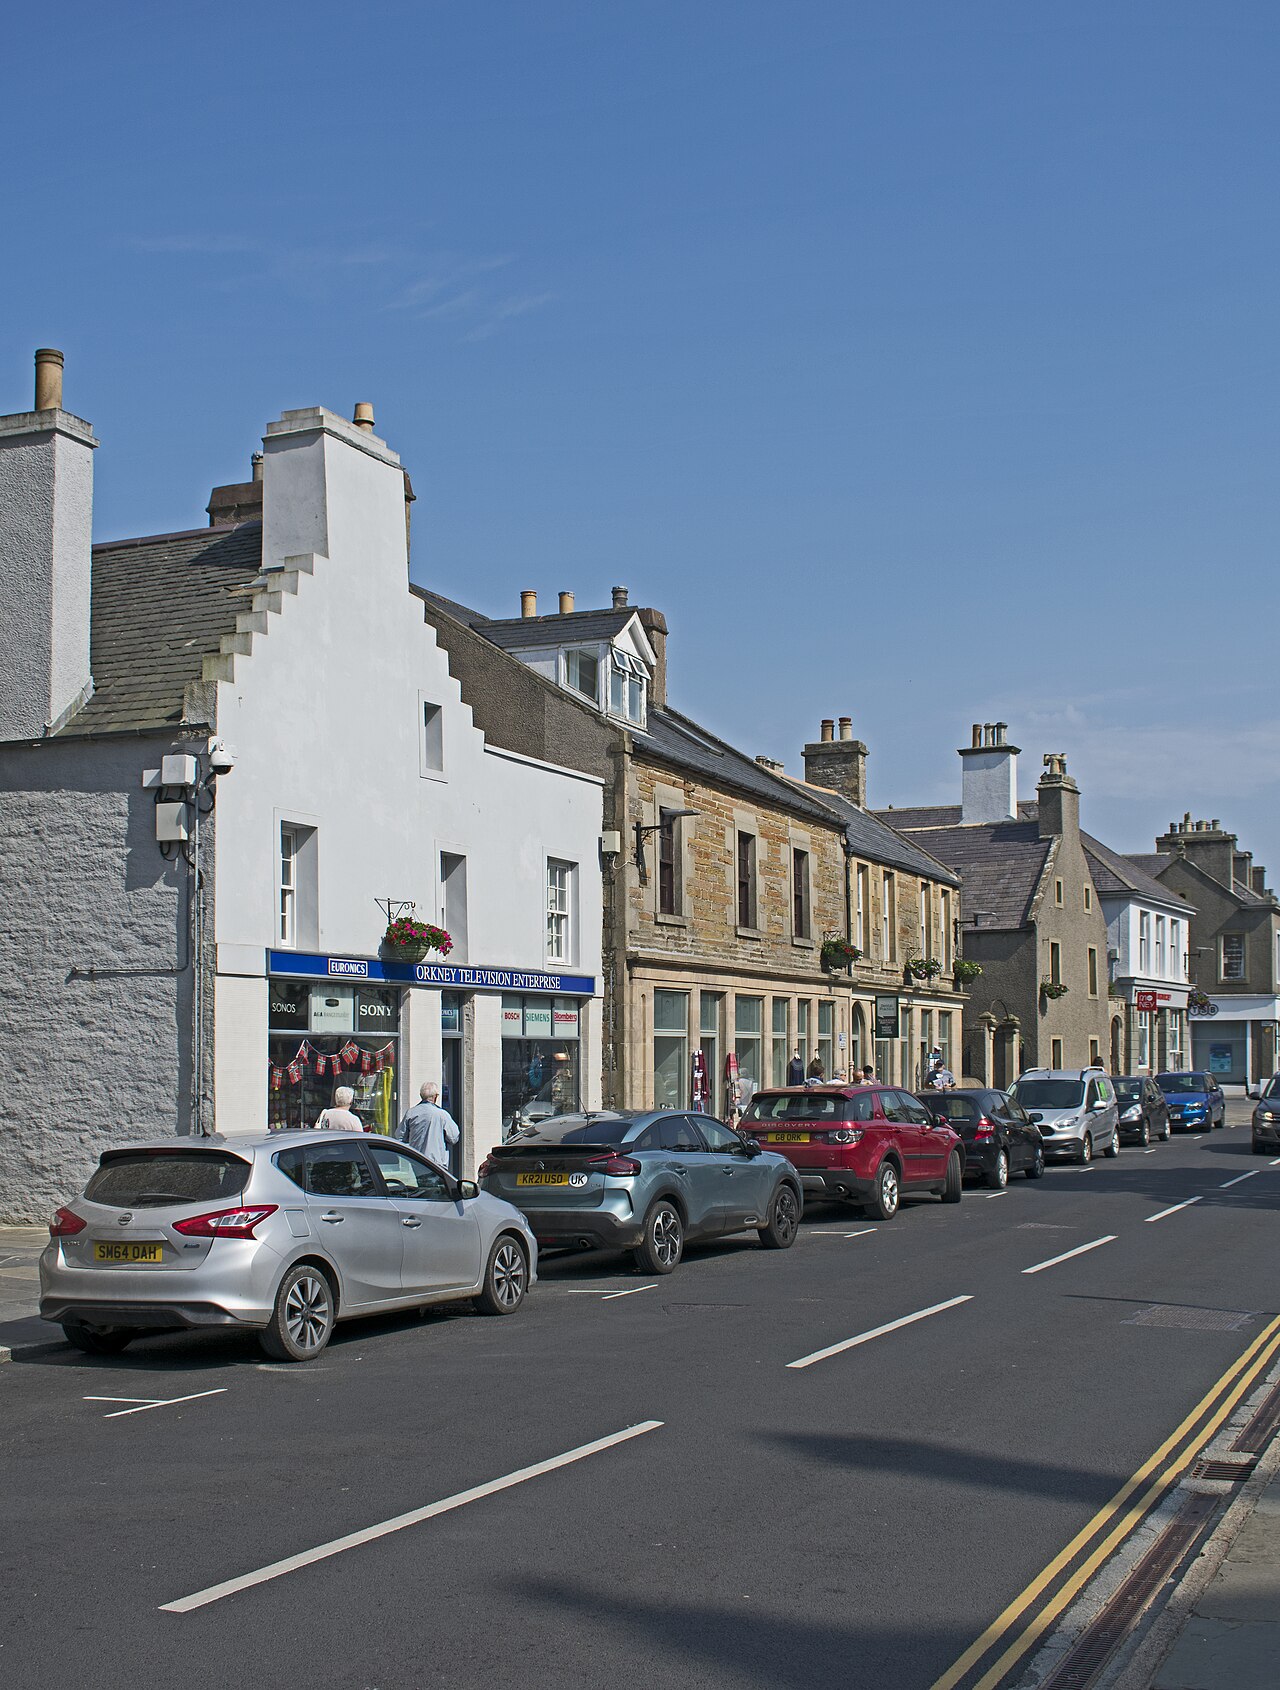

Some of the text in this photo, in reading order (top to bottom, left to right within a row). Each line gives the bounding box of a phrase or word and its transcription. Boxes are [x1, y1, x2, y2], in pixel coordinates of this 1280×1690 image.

[331, 961, 366, 974] EURONICS
[416, 965, 561, 990] ORKNEY TELEVISION ENTERPRISE
[271, 1002, 296, 1013] SONOS
[360, 1004, 393, 1017] SONY
[504, 1012, 520, 1020] BOSCH
[526, 1012, 550, 1022] SIEMENS
[554, 1012, 577, 1021] Blomberg
[786, 1133, 802, 1141] ORK
[522, 1174, 563, 1184] KR21 USO
[571, 1174, 585, 1185] UK
[98, 1245, 157, 1260] SM64 OAH
